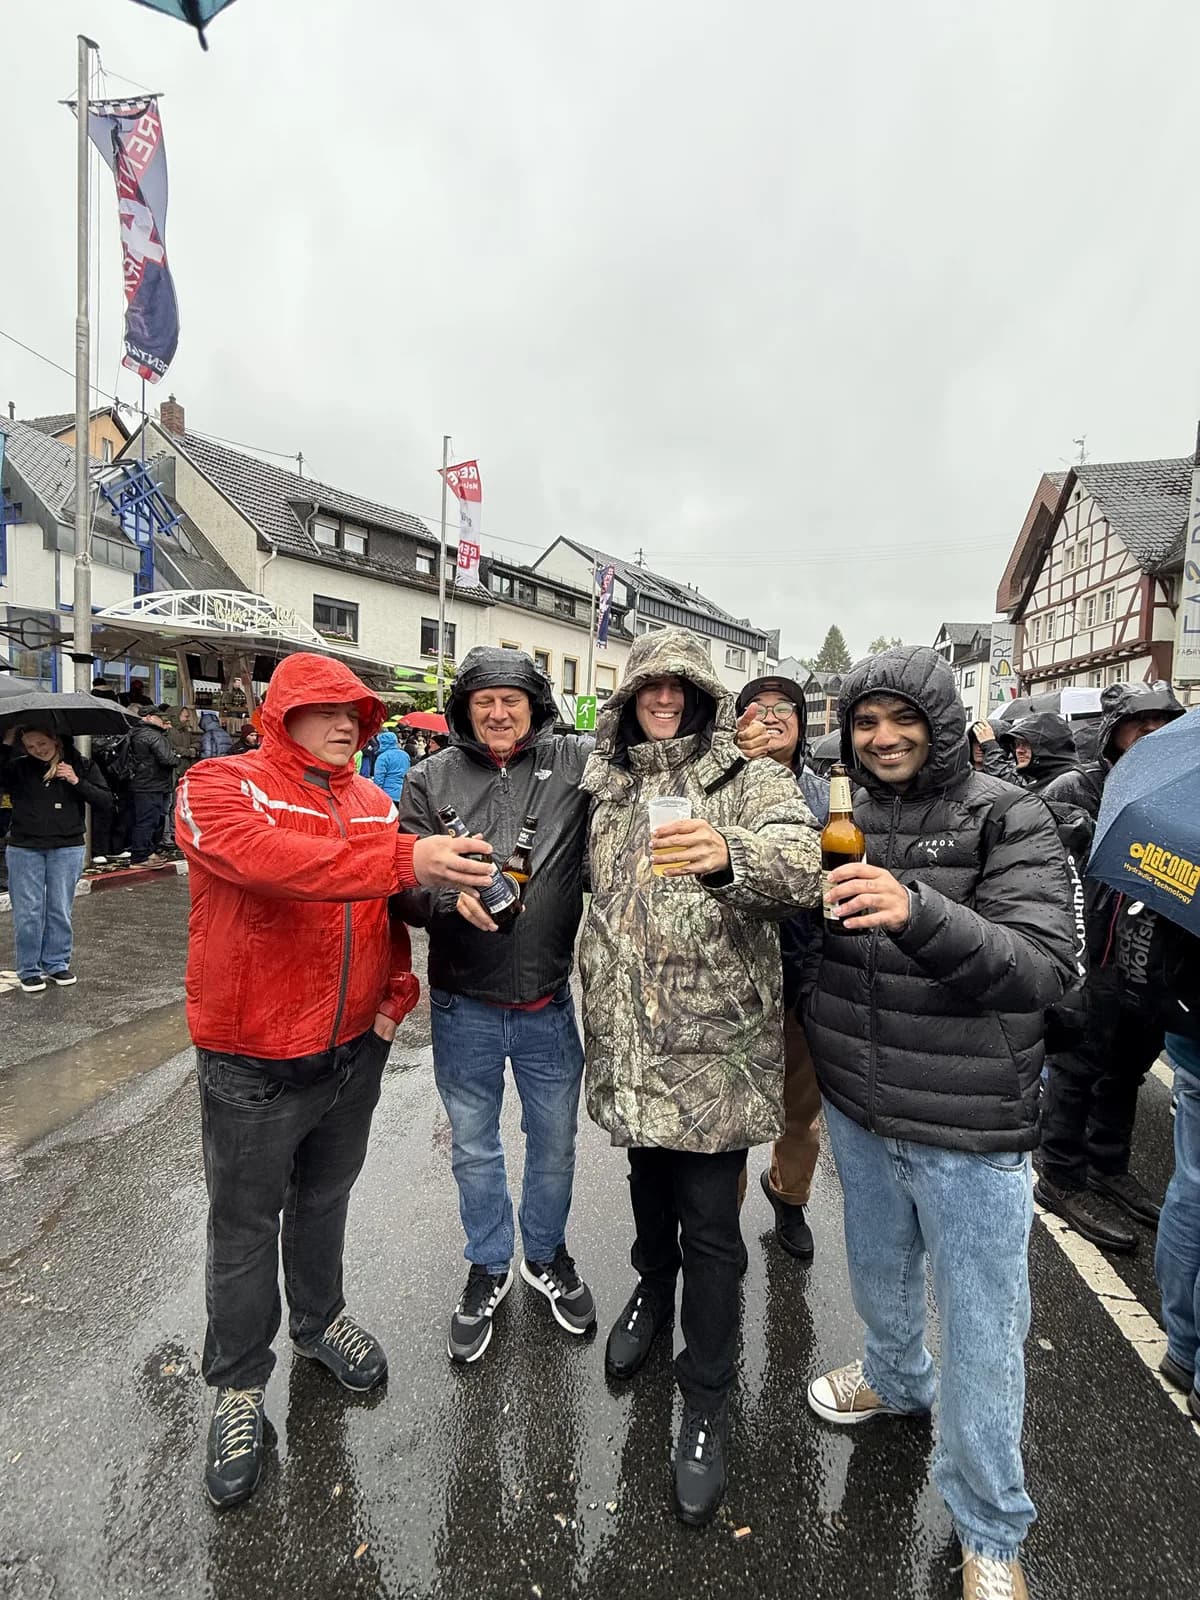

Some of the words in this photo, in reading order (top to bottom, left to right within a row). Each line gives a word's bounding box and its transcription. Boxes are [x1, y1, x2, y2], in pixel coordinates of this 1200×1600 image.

[1123, 862, 1153, 882] Hydraulic
[1154, 878, 1192, 905] Technology
[1139, 842, 1200, 891] pacoma
